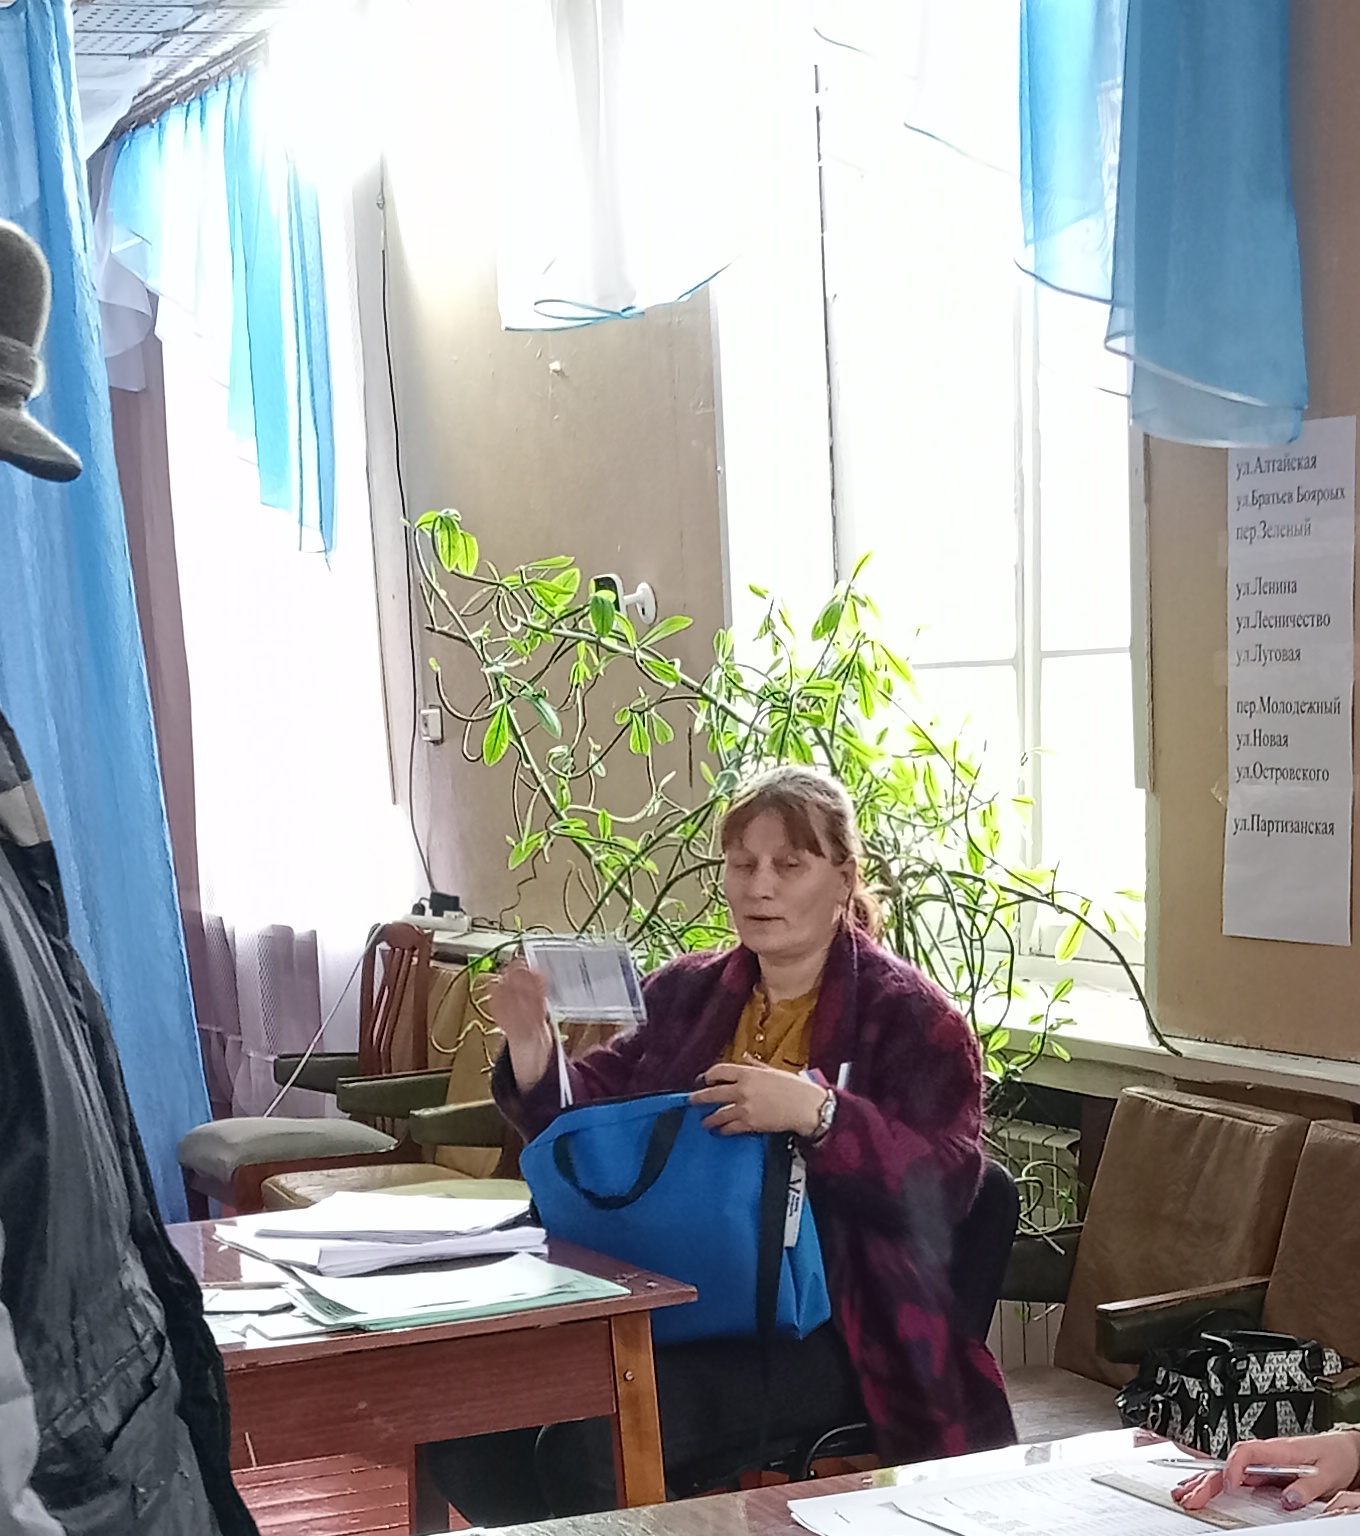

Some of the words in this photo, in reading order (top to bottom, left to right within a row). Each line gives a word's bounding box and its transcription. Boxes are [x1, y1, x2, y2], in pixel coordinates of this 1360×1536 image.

[1236, 453, 1317, 481] ул.Алтайская
[1236, 518, 1311, 544] пер.Зеленый
[1236, 576, 1297, 601] ул.Ленина
[1236, 610, 1331, 634] ул.Лесничество
[1236, 644, 1301, 667] ул.Луговая
[1236, 696, 1341, 719] пер.Молодежный
[1236, 728, 1289, 751] ул.Новая
[1236, 761, 1330, 784] ул.Островского
[1232, 814, 1335, 837] ул.Партизанская
